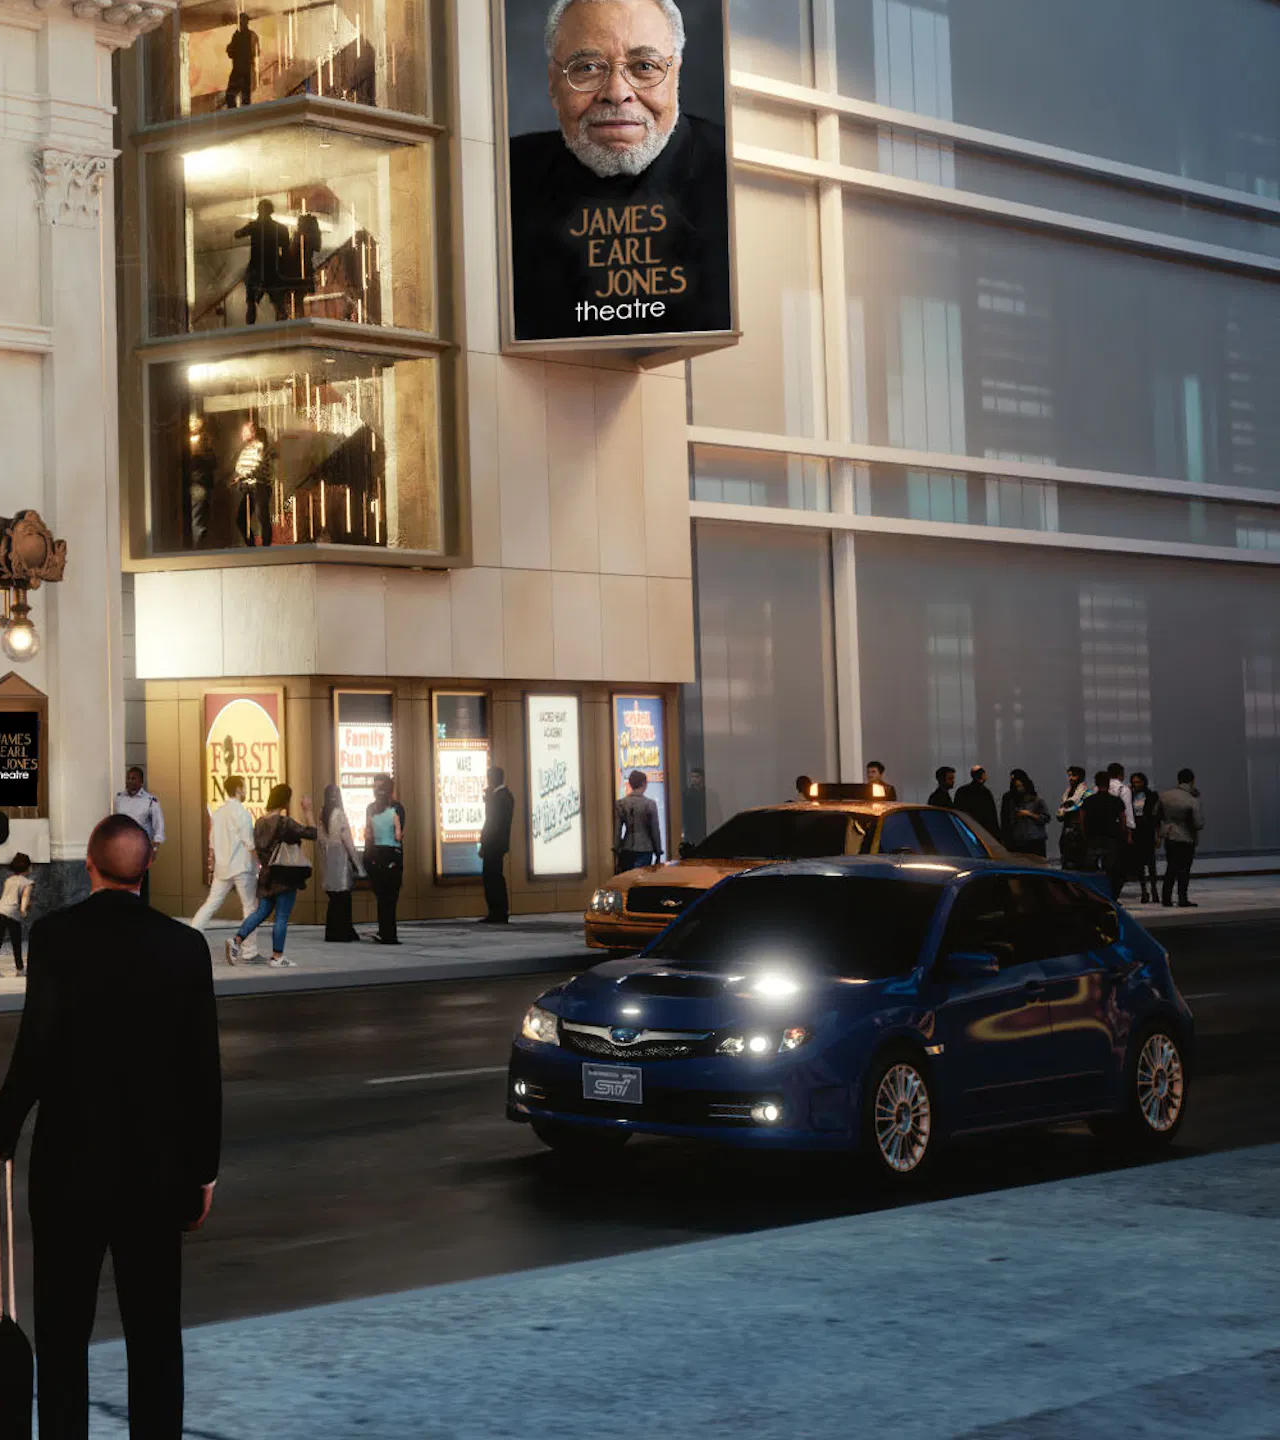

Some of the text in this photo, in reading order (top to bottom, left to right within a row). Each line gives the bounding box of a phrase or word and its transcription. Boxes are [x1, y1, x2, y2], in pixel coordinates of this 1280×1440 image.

[569, 204, 667, 237] JAMES
[588, 236, 662, 267] EARL
[595, 265, 687, 298] JONES
[575, 298, 666, 322] theatre
[345, 728, 384, 750] Family
[0, 746, 29, 758] EARL
[1, 758, 38, 770] JONES
[340, 750, 362, 768] Fun
[211, 775, 277, 803] NHT
